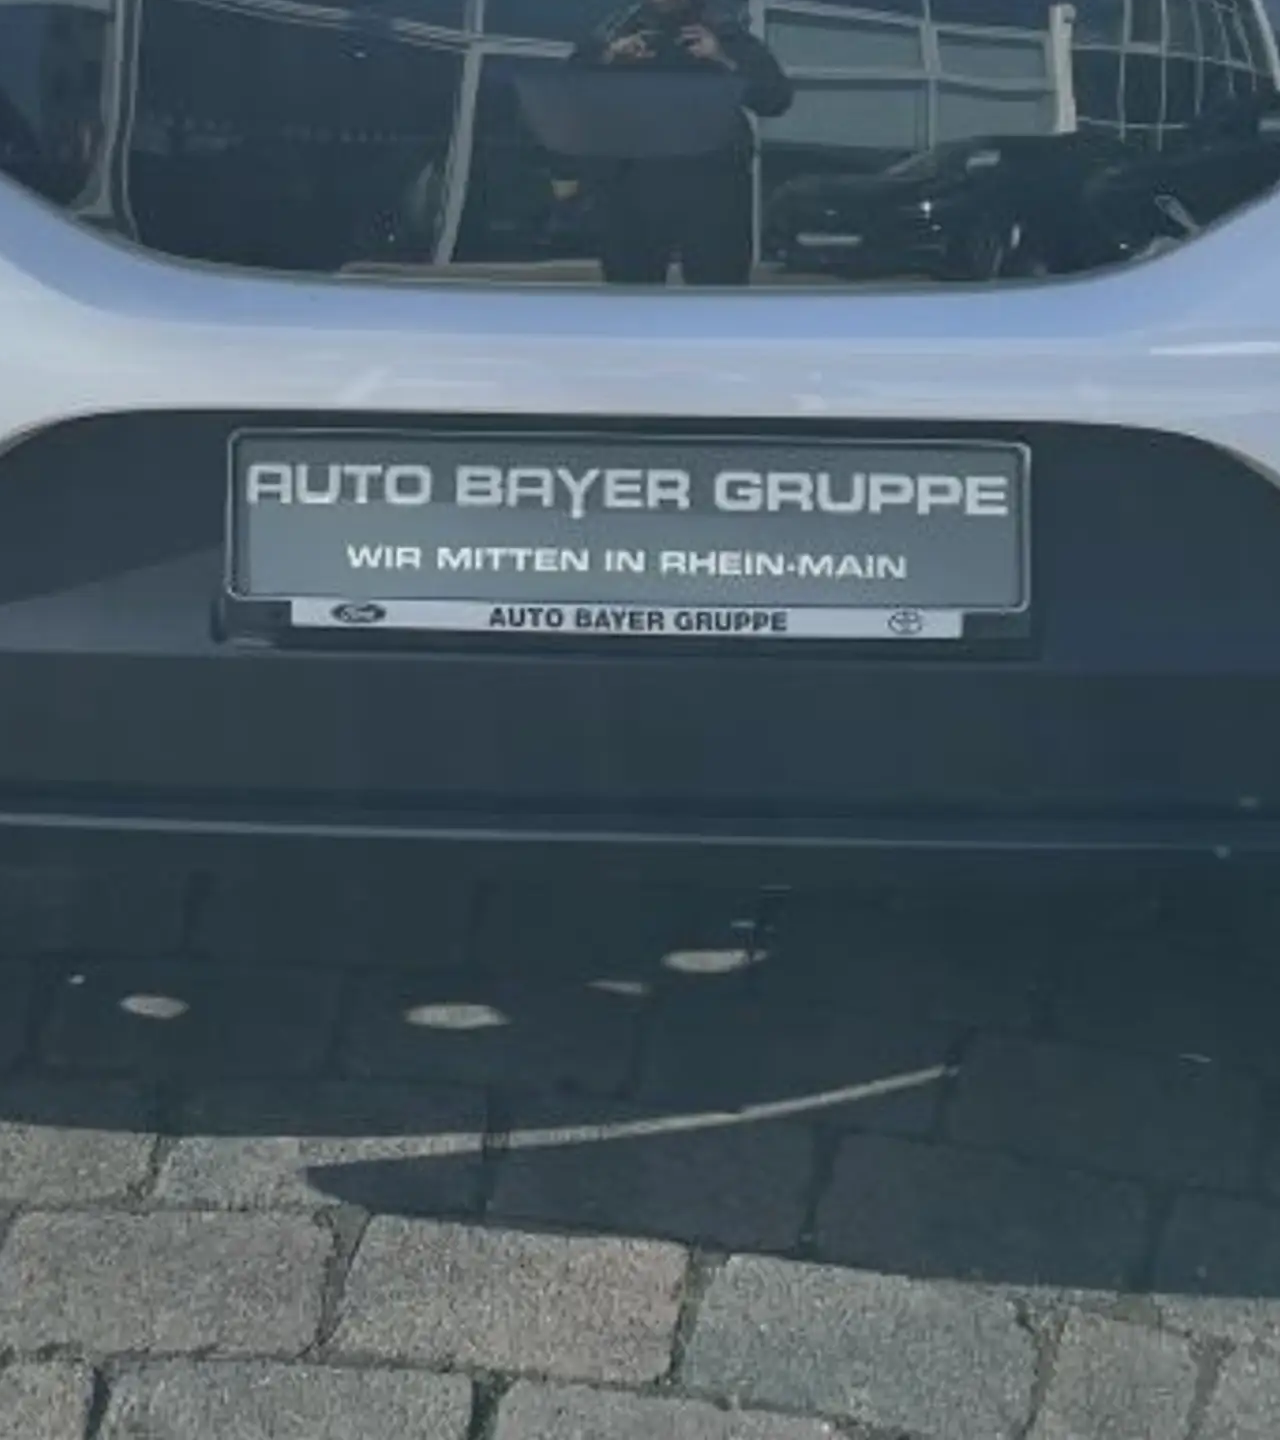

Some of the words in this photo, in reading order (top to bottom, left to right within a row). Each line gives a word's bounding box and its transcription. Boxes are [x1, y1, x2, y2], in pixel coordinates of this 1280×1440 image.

[246, 464, 431, 504] AUTO
[456, 466, 690, 519] BAYER
[714, 470, 1009, 516] GRUPPE
[347, 544, 421, 570] WIR
[437, 547, 588, 572] MITTEN
[605, 550, 645, 572] IN
[660, 550, 907, 578] RHEIN-MAIN
[489, 607, 563, 629] AUTO
[574, 610, 664, 631] BAYER
[674, 612, 788, 633] GRUPPE
